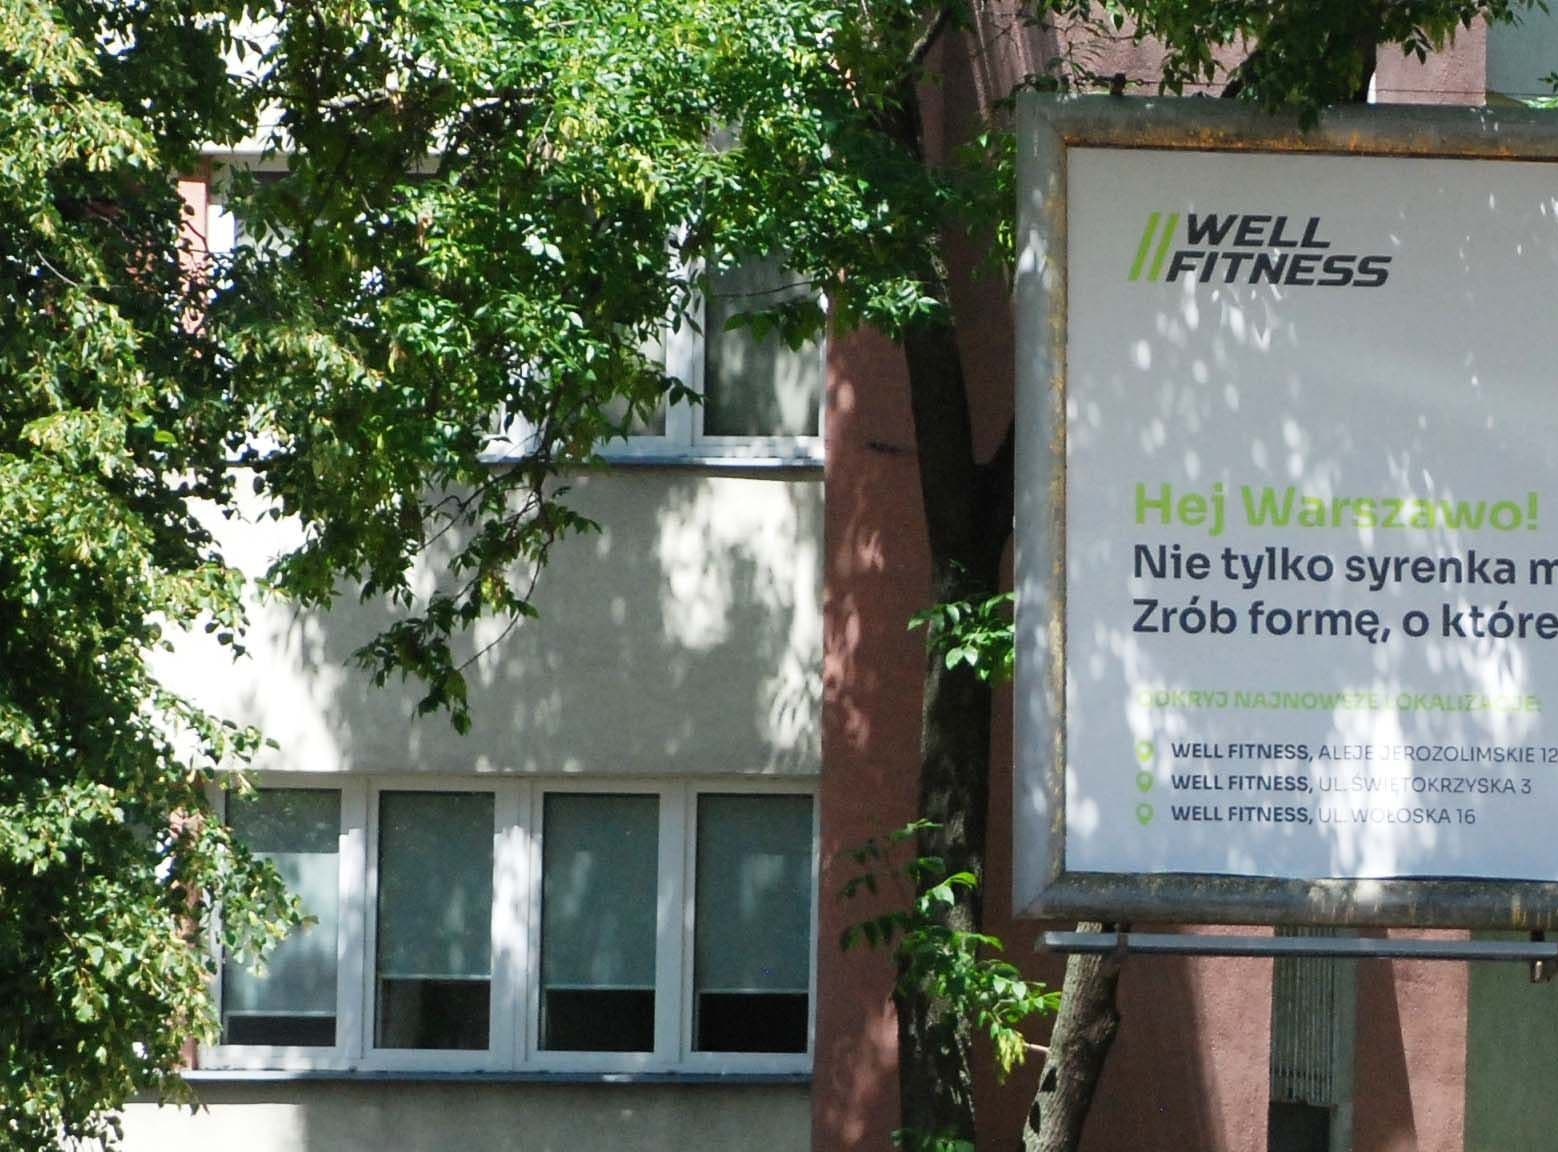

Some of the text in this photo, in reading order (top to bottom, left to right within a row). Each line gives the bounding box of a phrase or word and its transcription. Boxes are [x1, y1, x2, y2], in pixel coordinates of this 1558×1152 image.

[1186, 213, 1331, 248] WELL
[1165, 250, 1393, 288] FITNESS
[1133, 482, 1539, 536] Hej Warszawo!
[1133, 544, 1211, 580] Nie
[1221, 546, 1335, 590] tylko
[1345, 550, 1516, 592] syrenka
[1132, 596, 1238, 635] Zrób
[1248, 601, 1392, 644] formę,
[1402, 609, 1430, 638] o
[1233, 689, 1378, 711] NAJNOWSZE
[1171, 743, 1223, 759] WELL
[1228, 743, 1314, 762] FITNESS,
[1318, 745, 1373, 760] ALEJE
[1379, 745, 1535, 763] JEROZOLIMSKIE
[1171, 775, 1223, 790] WELL
[1228, 775, 1314, 794] FITNESS,
[1352, 769, 1517, 796] ŚWIĘTOKRZYSKA
[1521, 778, 1532, 794] 3
[1171, 805, 1223, 821] WELL
[1228, 806, 1314, 825] FITNESS,
[1351, 808, 1452, 824] WOŁOSKA
[1456, 809, 1477, 825] 16
